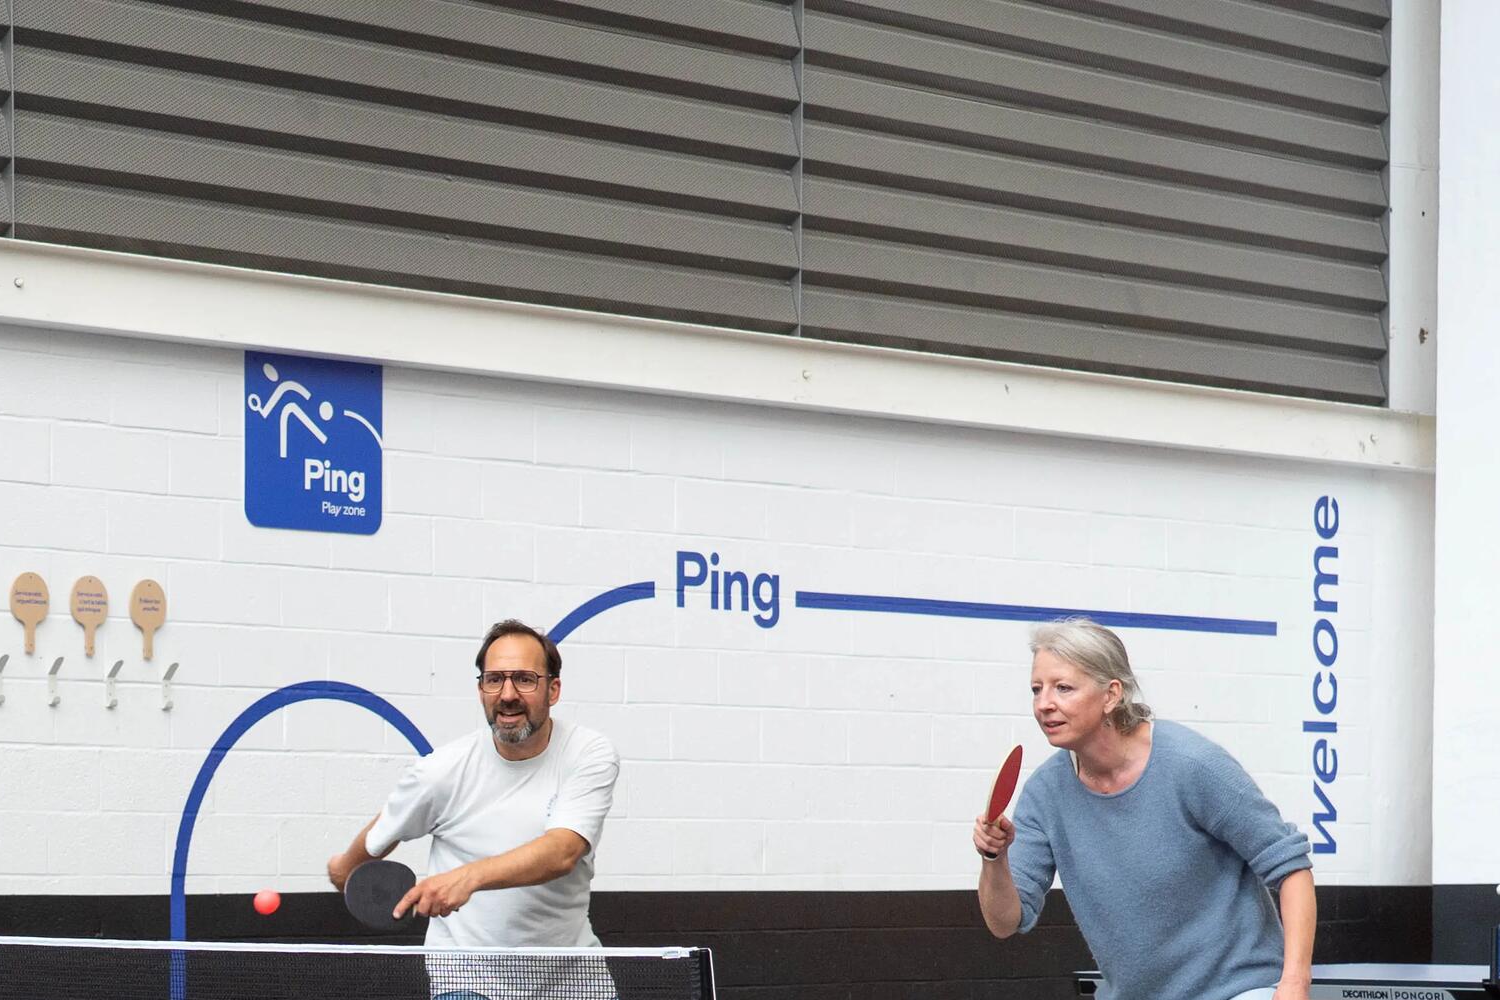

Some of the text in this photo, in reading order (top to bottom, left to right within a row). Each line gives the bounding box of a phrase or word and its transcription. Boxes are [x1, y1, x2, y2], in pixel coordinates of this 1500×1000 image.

[304, 458, 365, 503] Ping
[321, 501, 366, 517] Play zone
[676, 550, 780, 629] Ping
[1302, 495, 1339, 854] welcome
[1342, 989, 1444, 1000] DECATHLON PONGORI
